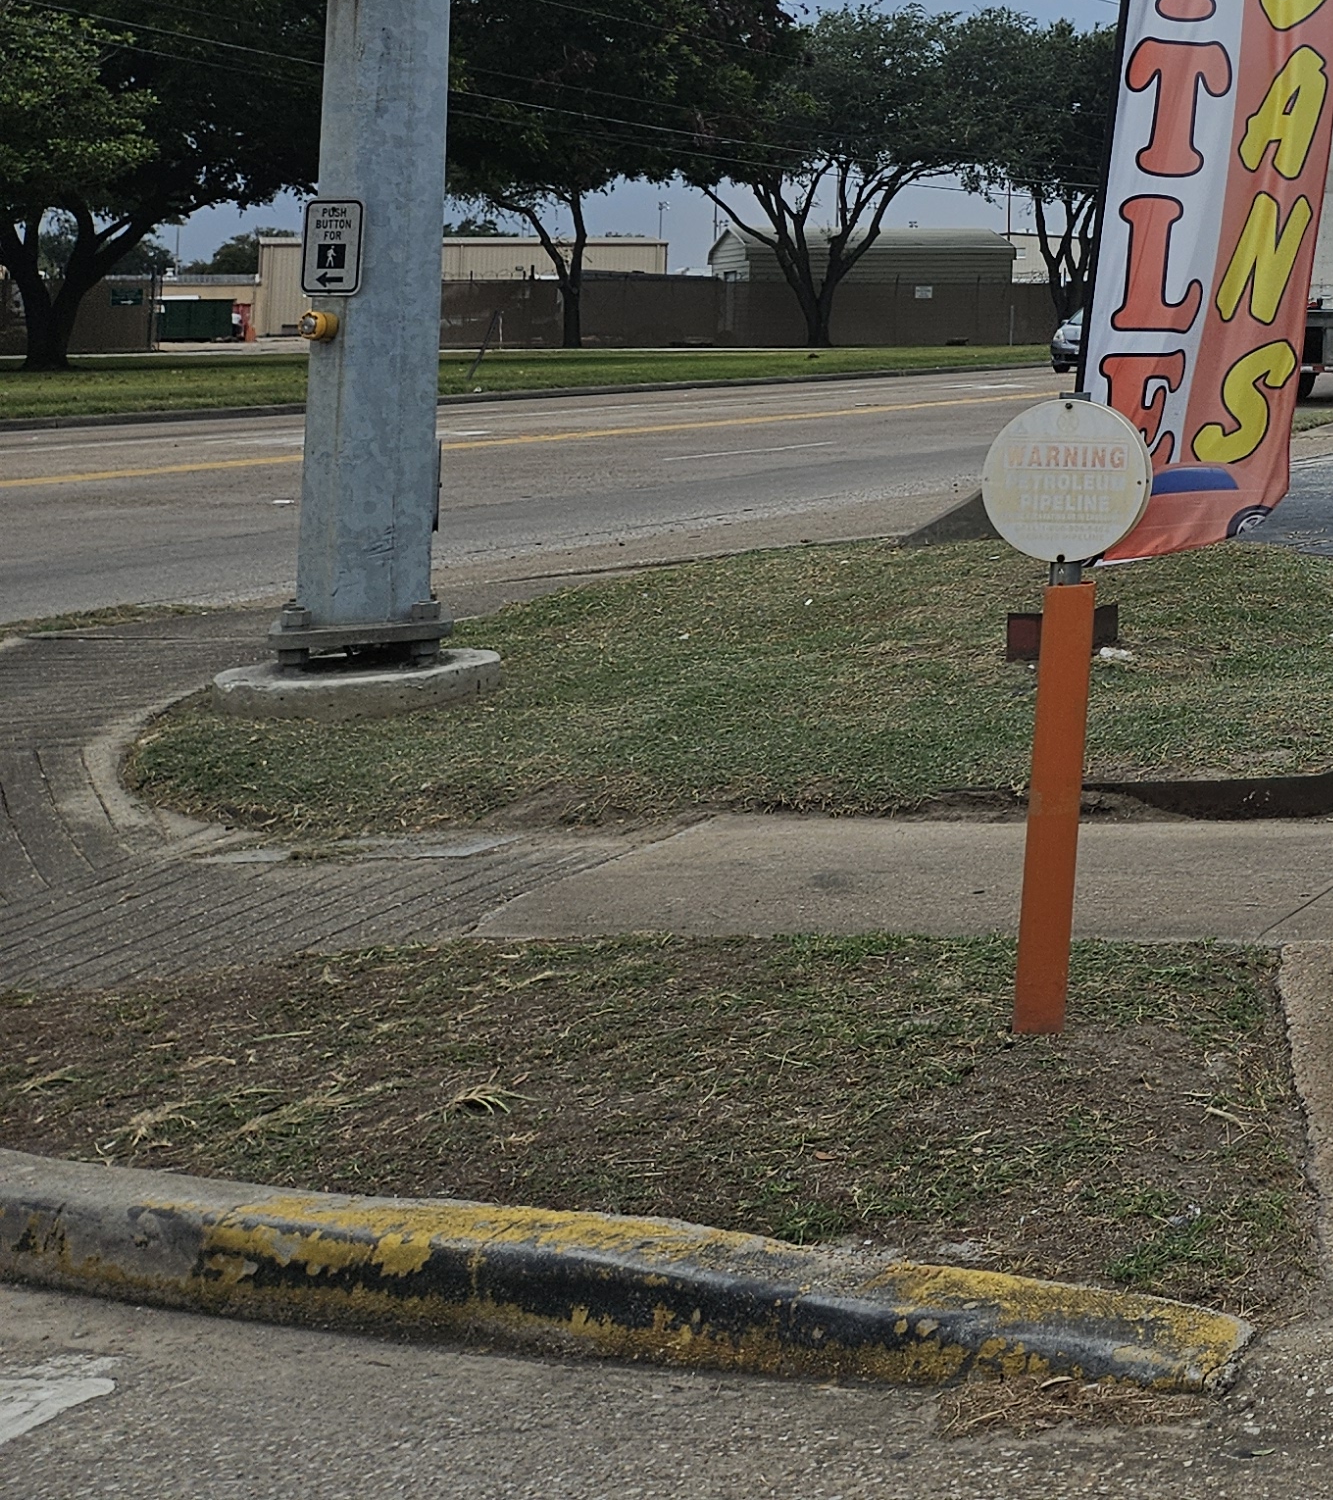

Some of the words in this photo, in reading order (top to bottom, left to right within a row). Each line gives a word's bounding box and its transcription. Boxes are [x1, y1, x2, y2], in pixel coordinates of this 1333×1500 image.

[323, 207, 347, 217] PUSH
[316, 219, 351, 229] BUTTON
[324, 231, 341, 240] FOR
[1007, 444, 1126, 468] WARNING
[1004, 473, 1126, 491] PETROLEUM
[1020, 493, 1111, 511] PIPELINE
